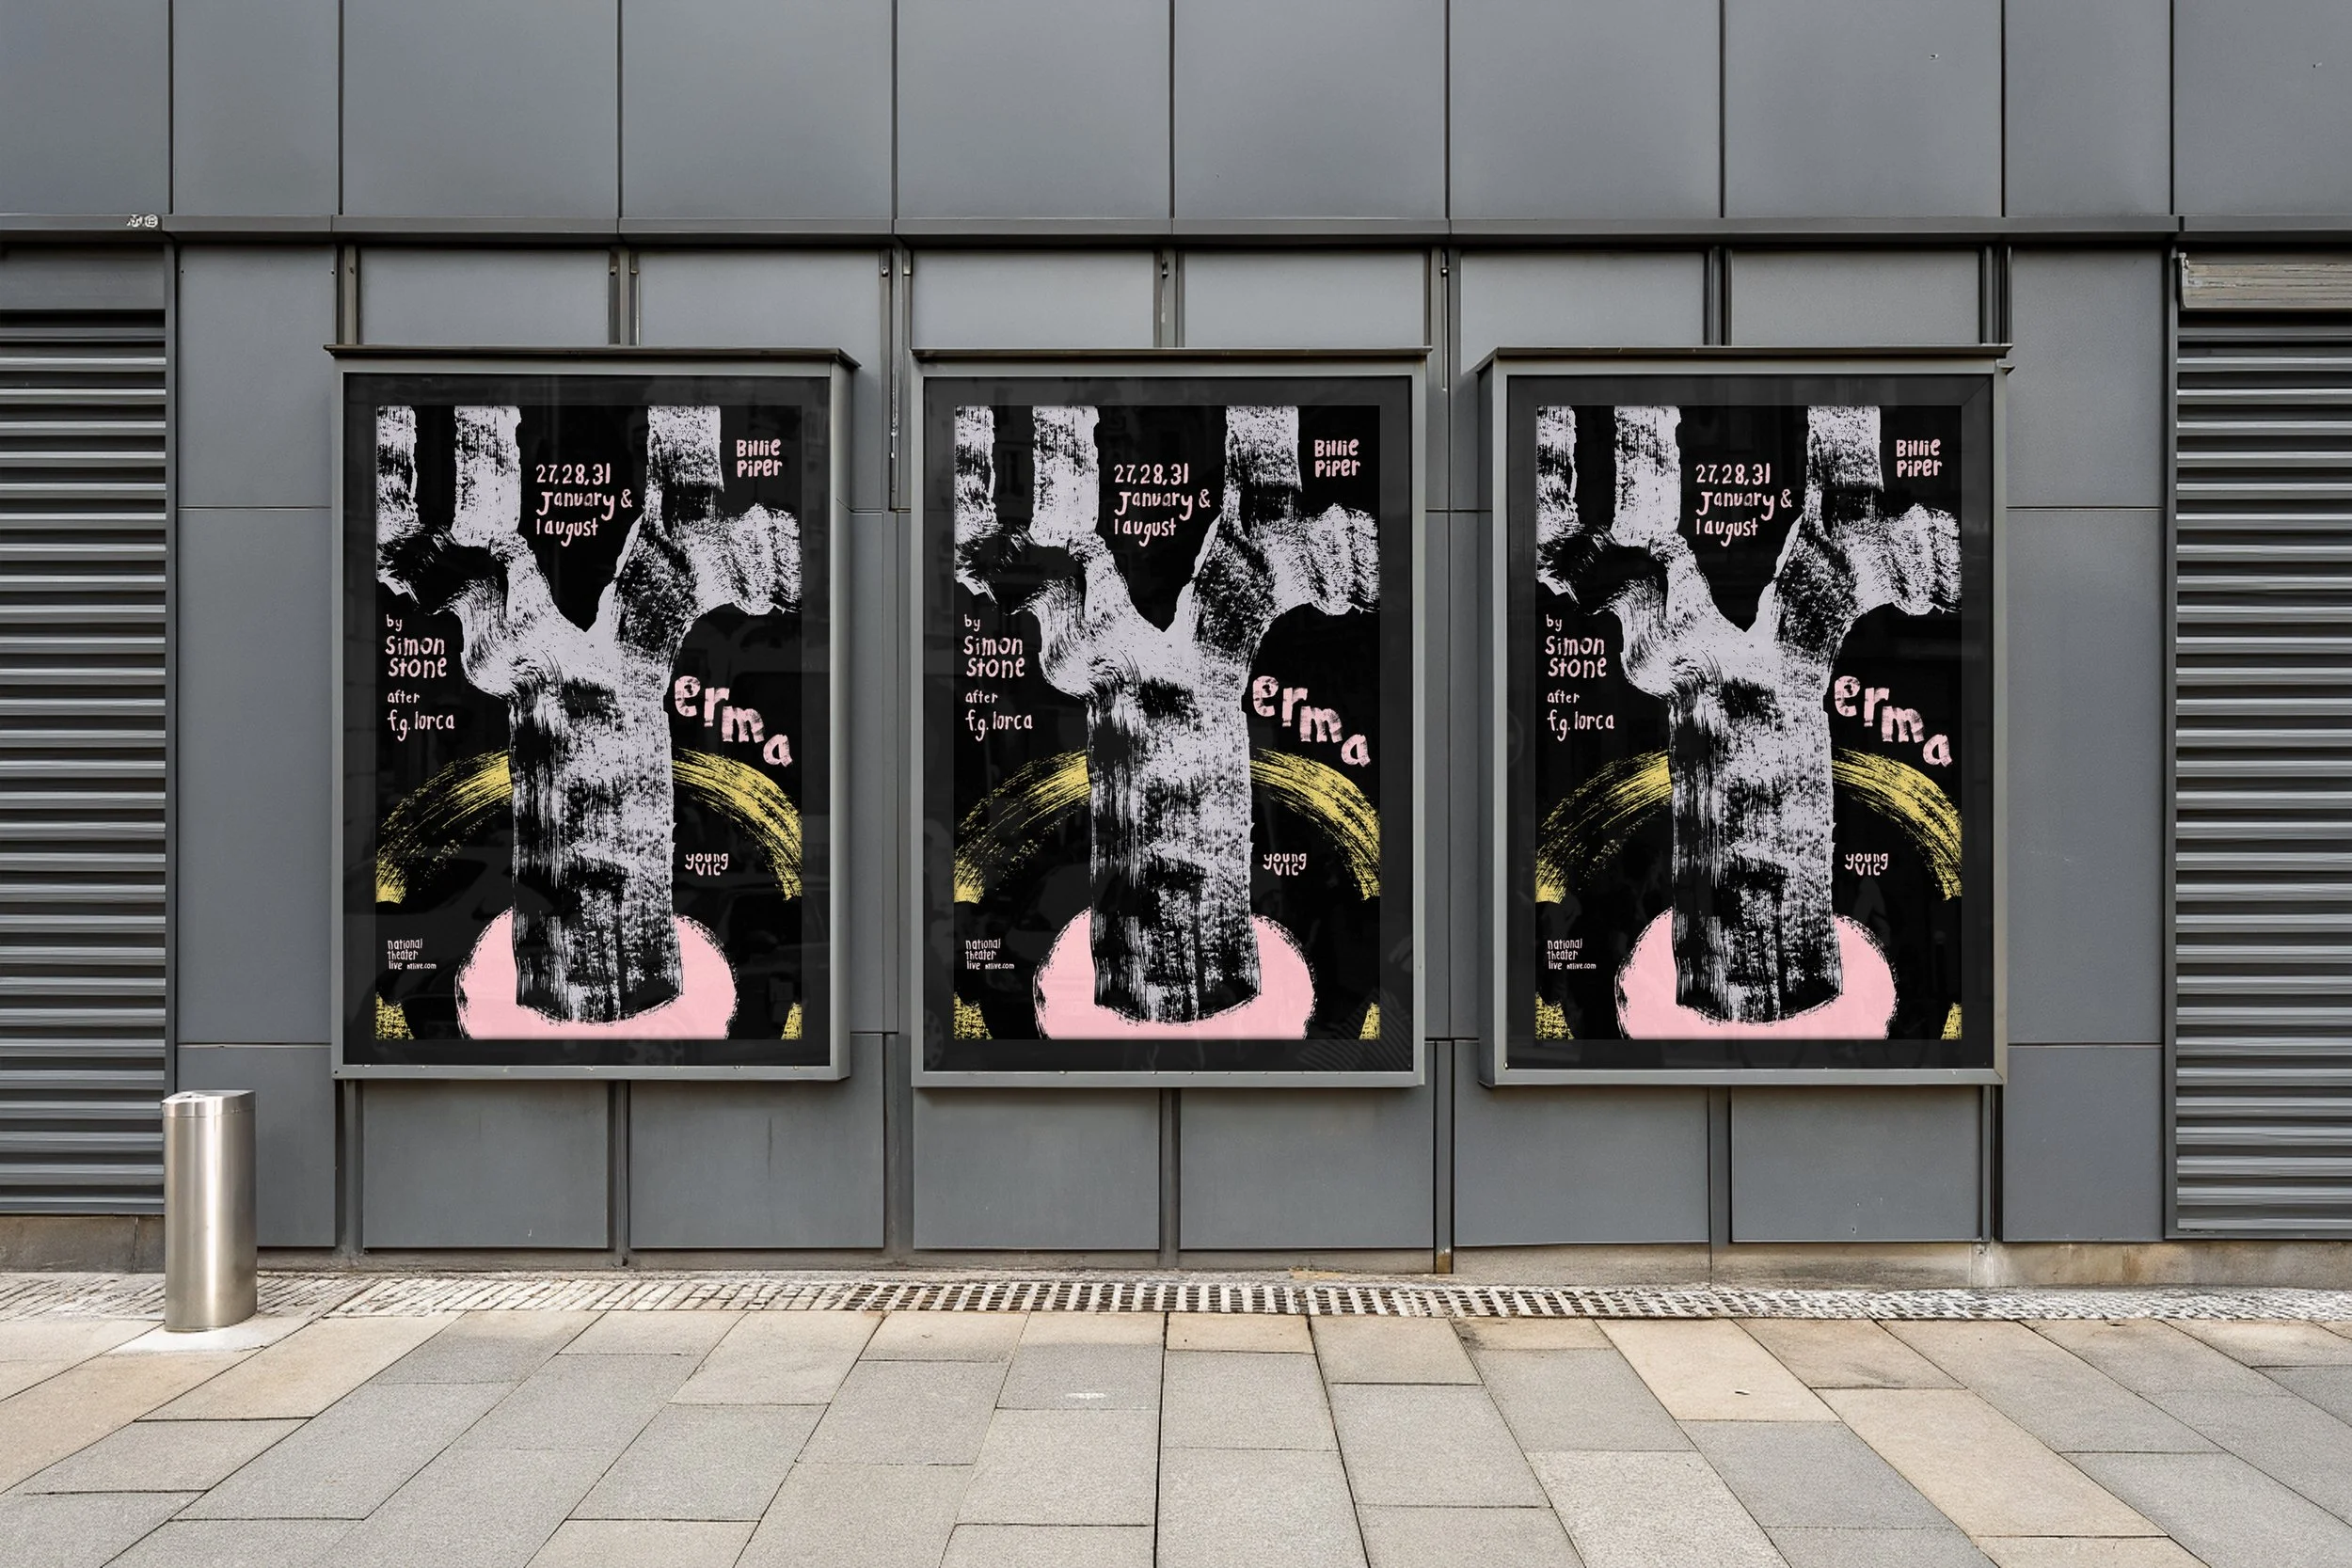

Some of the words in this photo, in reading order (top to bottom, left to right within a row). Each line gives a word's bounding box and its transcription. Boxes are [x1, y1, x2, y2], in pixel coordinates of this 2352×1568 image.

[535, 490, 615, 522] January
[620, 488, 633, 509] &
[1113, 490, 1193, 522] January
[1198, 488, 1211, 509] &
[1695, 490, 1775, 522] January
[1780, 488, 1793, 509] &
[544, 517, 599, 547] august
[1121, 517, 1177, 547] august
[1704, 517, 1759, 547] august
[386, 613, 403, 632] by
[963, 613, 980, 632] by
[1546, 613, 1563, 632] by
[385, 635, 445, 657] Simon
[962, 635, 1023, 657] Simon
[1545, 635, 1605, 657] Simon
[387, 689, 421, 704] after
[964, 689, 998, 704] after
[1547, 689, 1581, 704] after
[414, 710, 455, 731] lorca
[992, 710, 1033, 731] lorca
[1574, 710, 1615, 731] lorca
[684, 852, 729, 871] young
[1262, 852, 1307, 871] young
[1844, 852, 1889, 871] young
[387, 938, 423, 950] national
[964, 938, 1001, 950] national
[1547, 938, 1583, 950] national
[387, 949, 419, 960] theater
[964, 949, 996, 960] theater
[1547, 949, 1579, 960] theater
[388, 959, 403, 971] live
[965, 959, 980, 971] live
[1548, 959, 1563, 971] live
